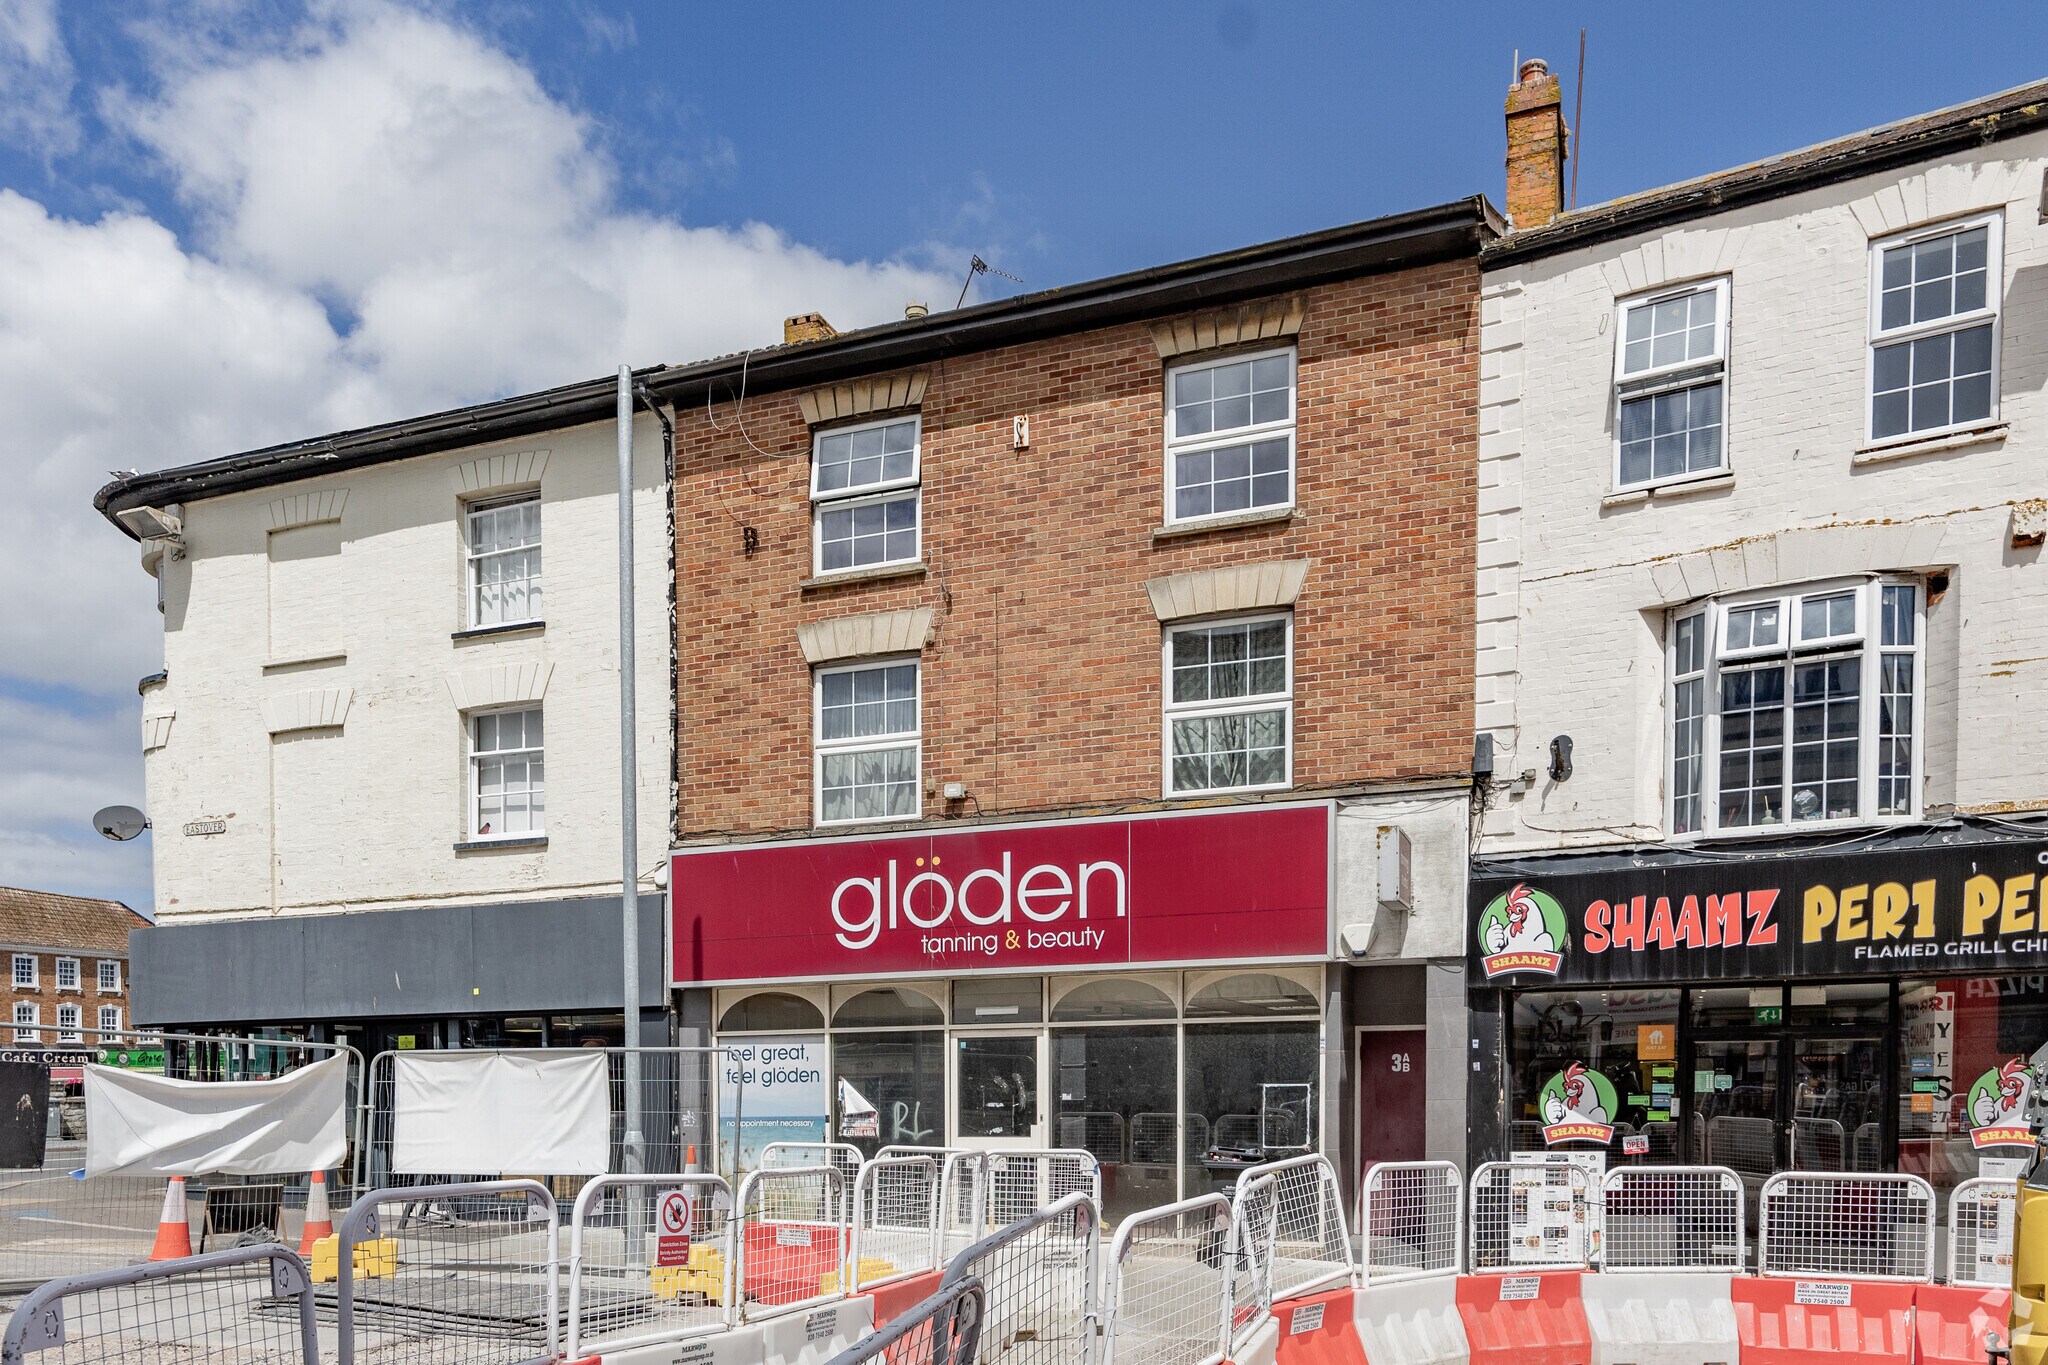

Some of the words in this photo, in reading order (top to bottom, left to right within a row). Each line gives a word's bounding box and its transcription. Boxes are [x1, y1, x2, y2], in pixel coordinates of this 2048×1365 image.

[186, 823, 223, 835] EASTOVER
[831, 851, 1126, 950] glöden
[1584, 888, 1781, 954] SHAAMZ
[1962, 872, 2048, 938] PE
[921, 932, 998, 956] tanning
[1005, 929, 1021, 950] &
[1028, 926, 1105, 950] beauty
[1854, 943, 1938, 960] FLAMED
[1944, 941, 2007, 956] GRILL
[1491, 953, 1552, 970] SHAAMZ
[1, 1051, 36, 1063] Cafe
[42, 1051, 89, 1064] Cream
[761, 1044, 809, 1065] great,
[726, 1068, 756, 1084] feel
[761, 1066, 820, 1088] glöden
[739, 1119, 779, 1127] ppointment
[780, 1120, 815, 1128] necessary
[1550, 1126, 1606, 1139] SHAAMZ
[1626, 1140, 1645, 1149] OPEN
